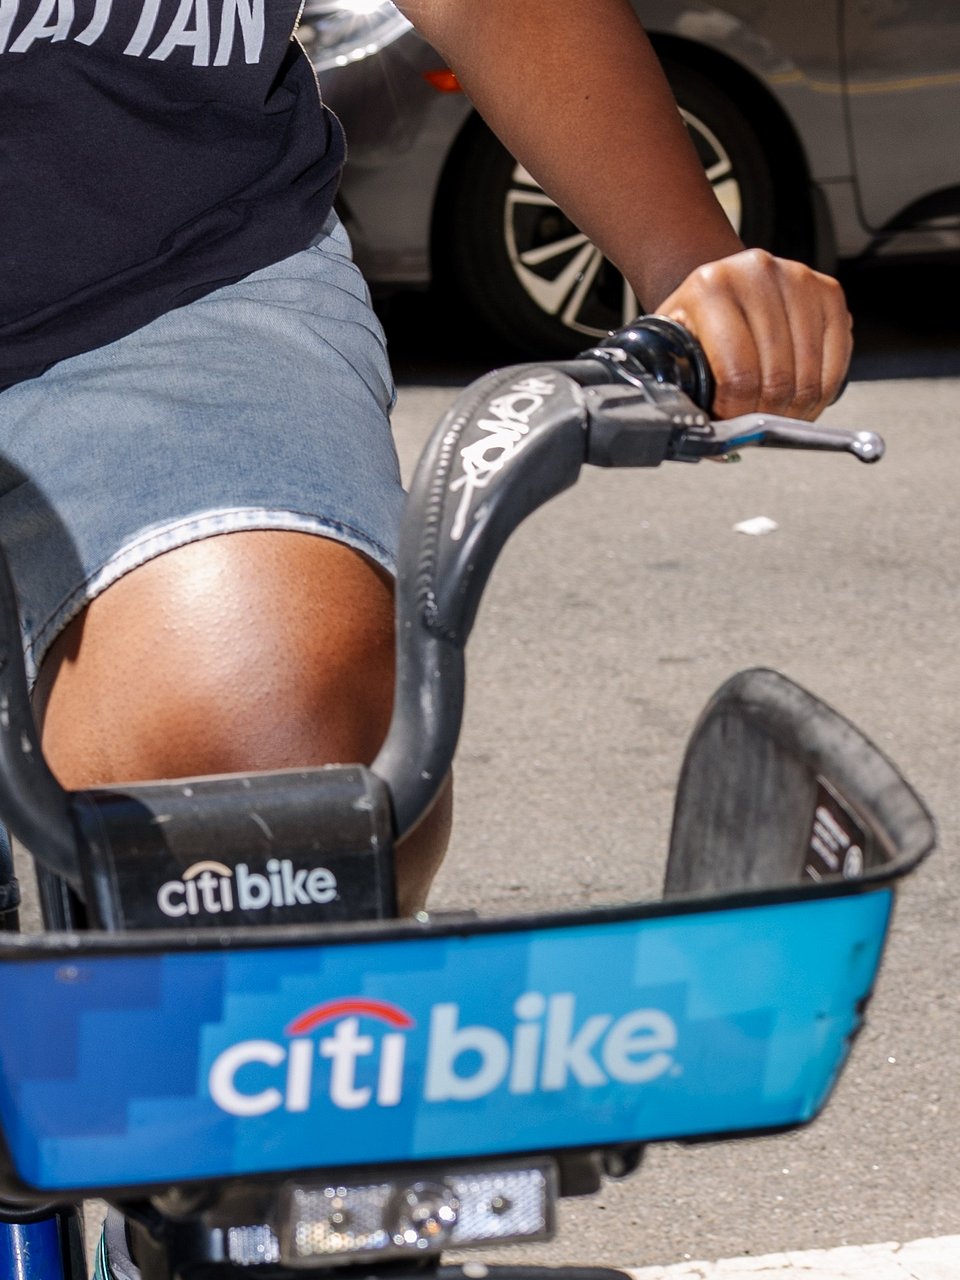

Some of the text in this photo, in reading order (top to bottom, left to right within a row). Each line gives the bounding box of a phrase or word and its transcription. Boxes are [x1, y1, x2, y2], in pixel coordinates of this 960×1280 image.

[156, 858, 338, 918] citi bike
[208, 992, 678, 1117] citi bike
